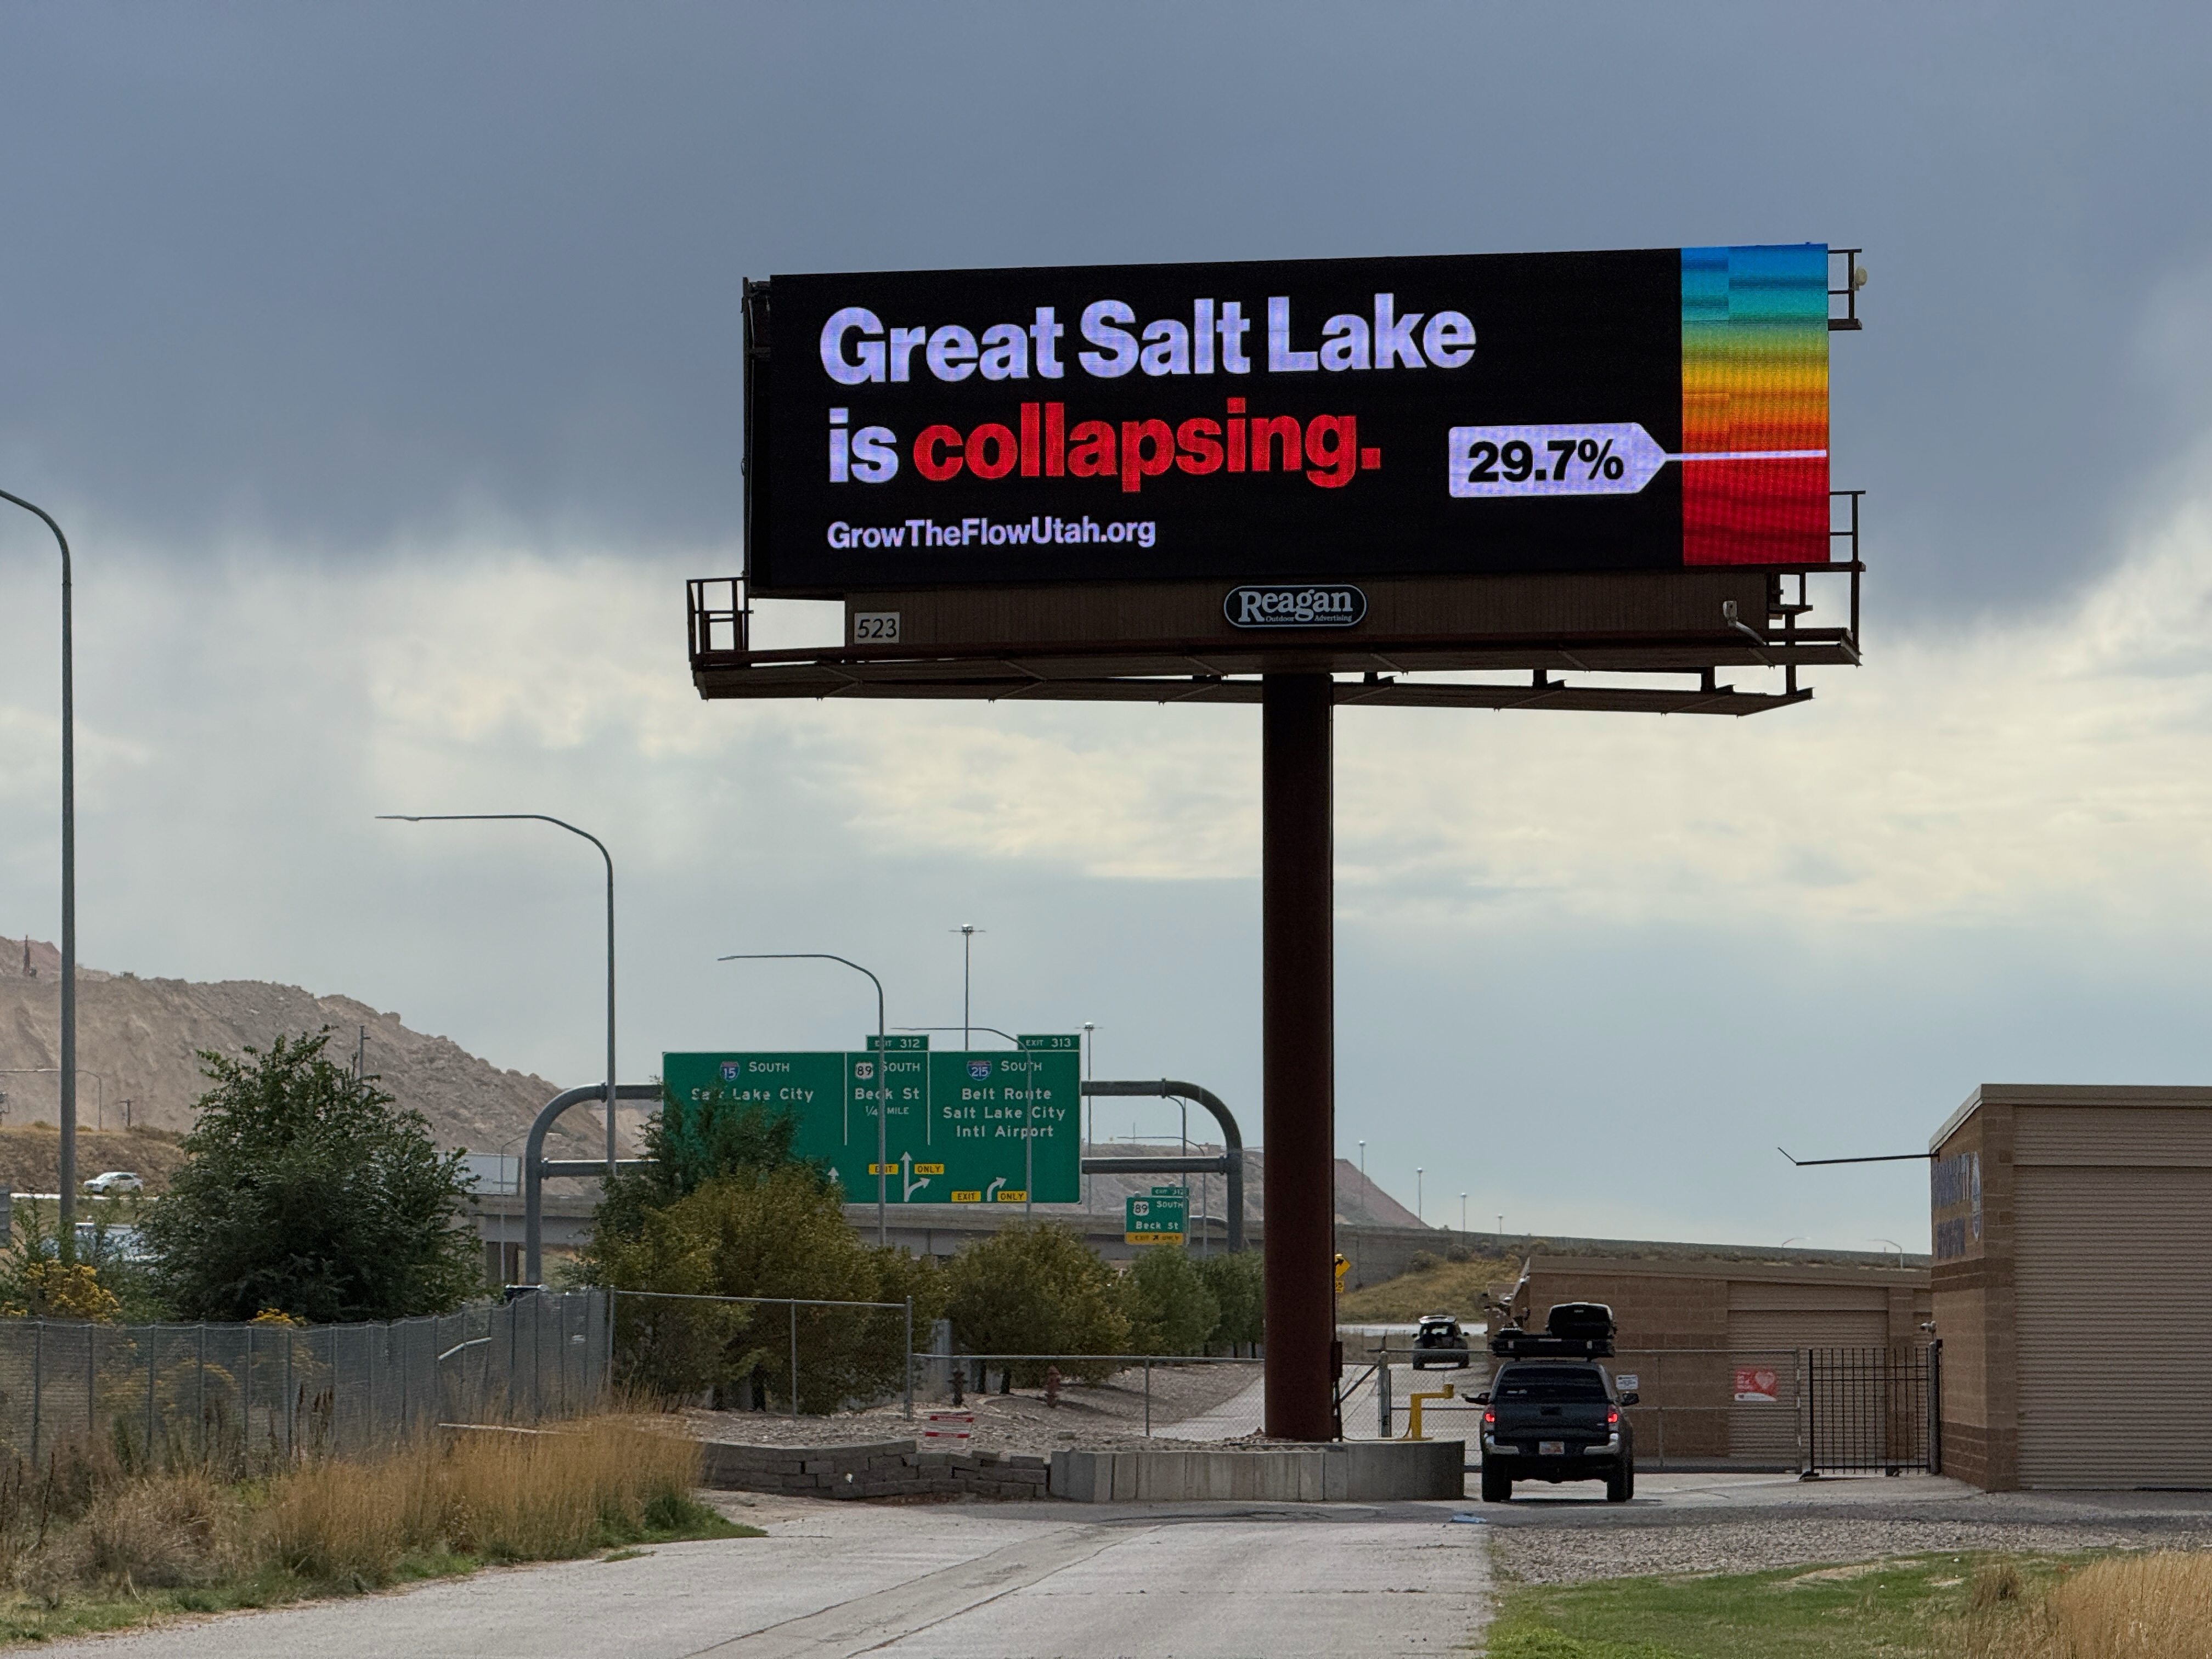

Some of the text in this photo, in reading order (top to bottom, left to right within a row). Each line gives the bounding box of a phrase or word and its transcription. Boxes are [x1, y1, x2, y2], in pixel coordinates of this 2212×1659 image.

[820, 293, 1476, 385] Great Salt Lake
[830, 398, 1380, 492] is collapsing.
[1469, 439, 1624, 482] 29.7%
[828, 516, 1155, 549] GrowTheFlowUtah.org
[1238, 589, 1353, 622] Reagan
[1314, 614, 1352, 623] Advertising
[857, 618, 897, 639] 523
[900, 1039, 920, 1048] 312
[1051, 1038, 1071, 1047] 313
[723, 1062, 789, 1079] 15 SOUTH
[857, 1066, 872, 1076] 89
[971, 1067, 988, 1077] 215
[733, 1088, 771, 1100] Lake
[780, 1088, 814, 1103] City
[855, 1087, 919, 1100] Beck St
[962, 1088, 1052, 1100] Belt Route
[887, 1107, 909, 1115] MILE
[943, 1106, 1065, 1121] Salt Lake City
[956, 1125, 1053, 1139] Intl Airport
[1135, 1204, 1148, 1213] 89
[1136, 1221, 1161, 1229] Beck
